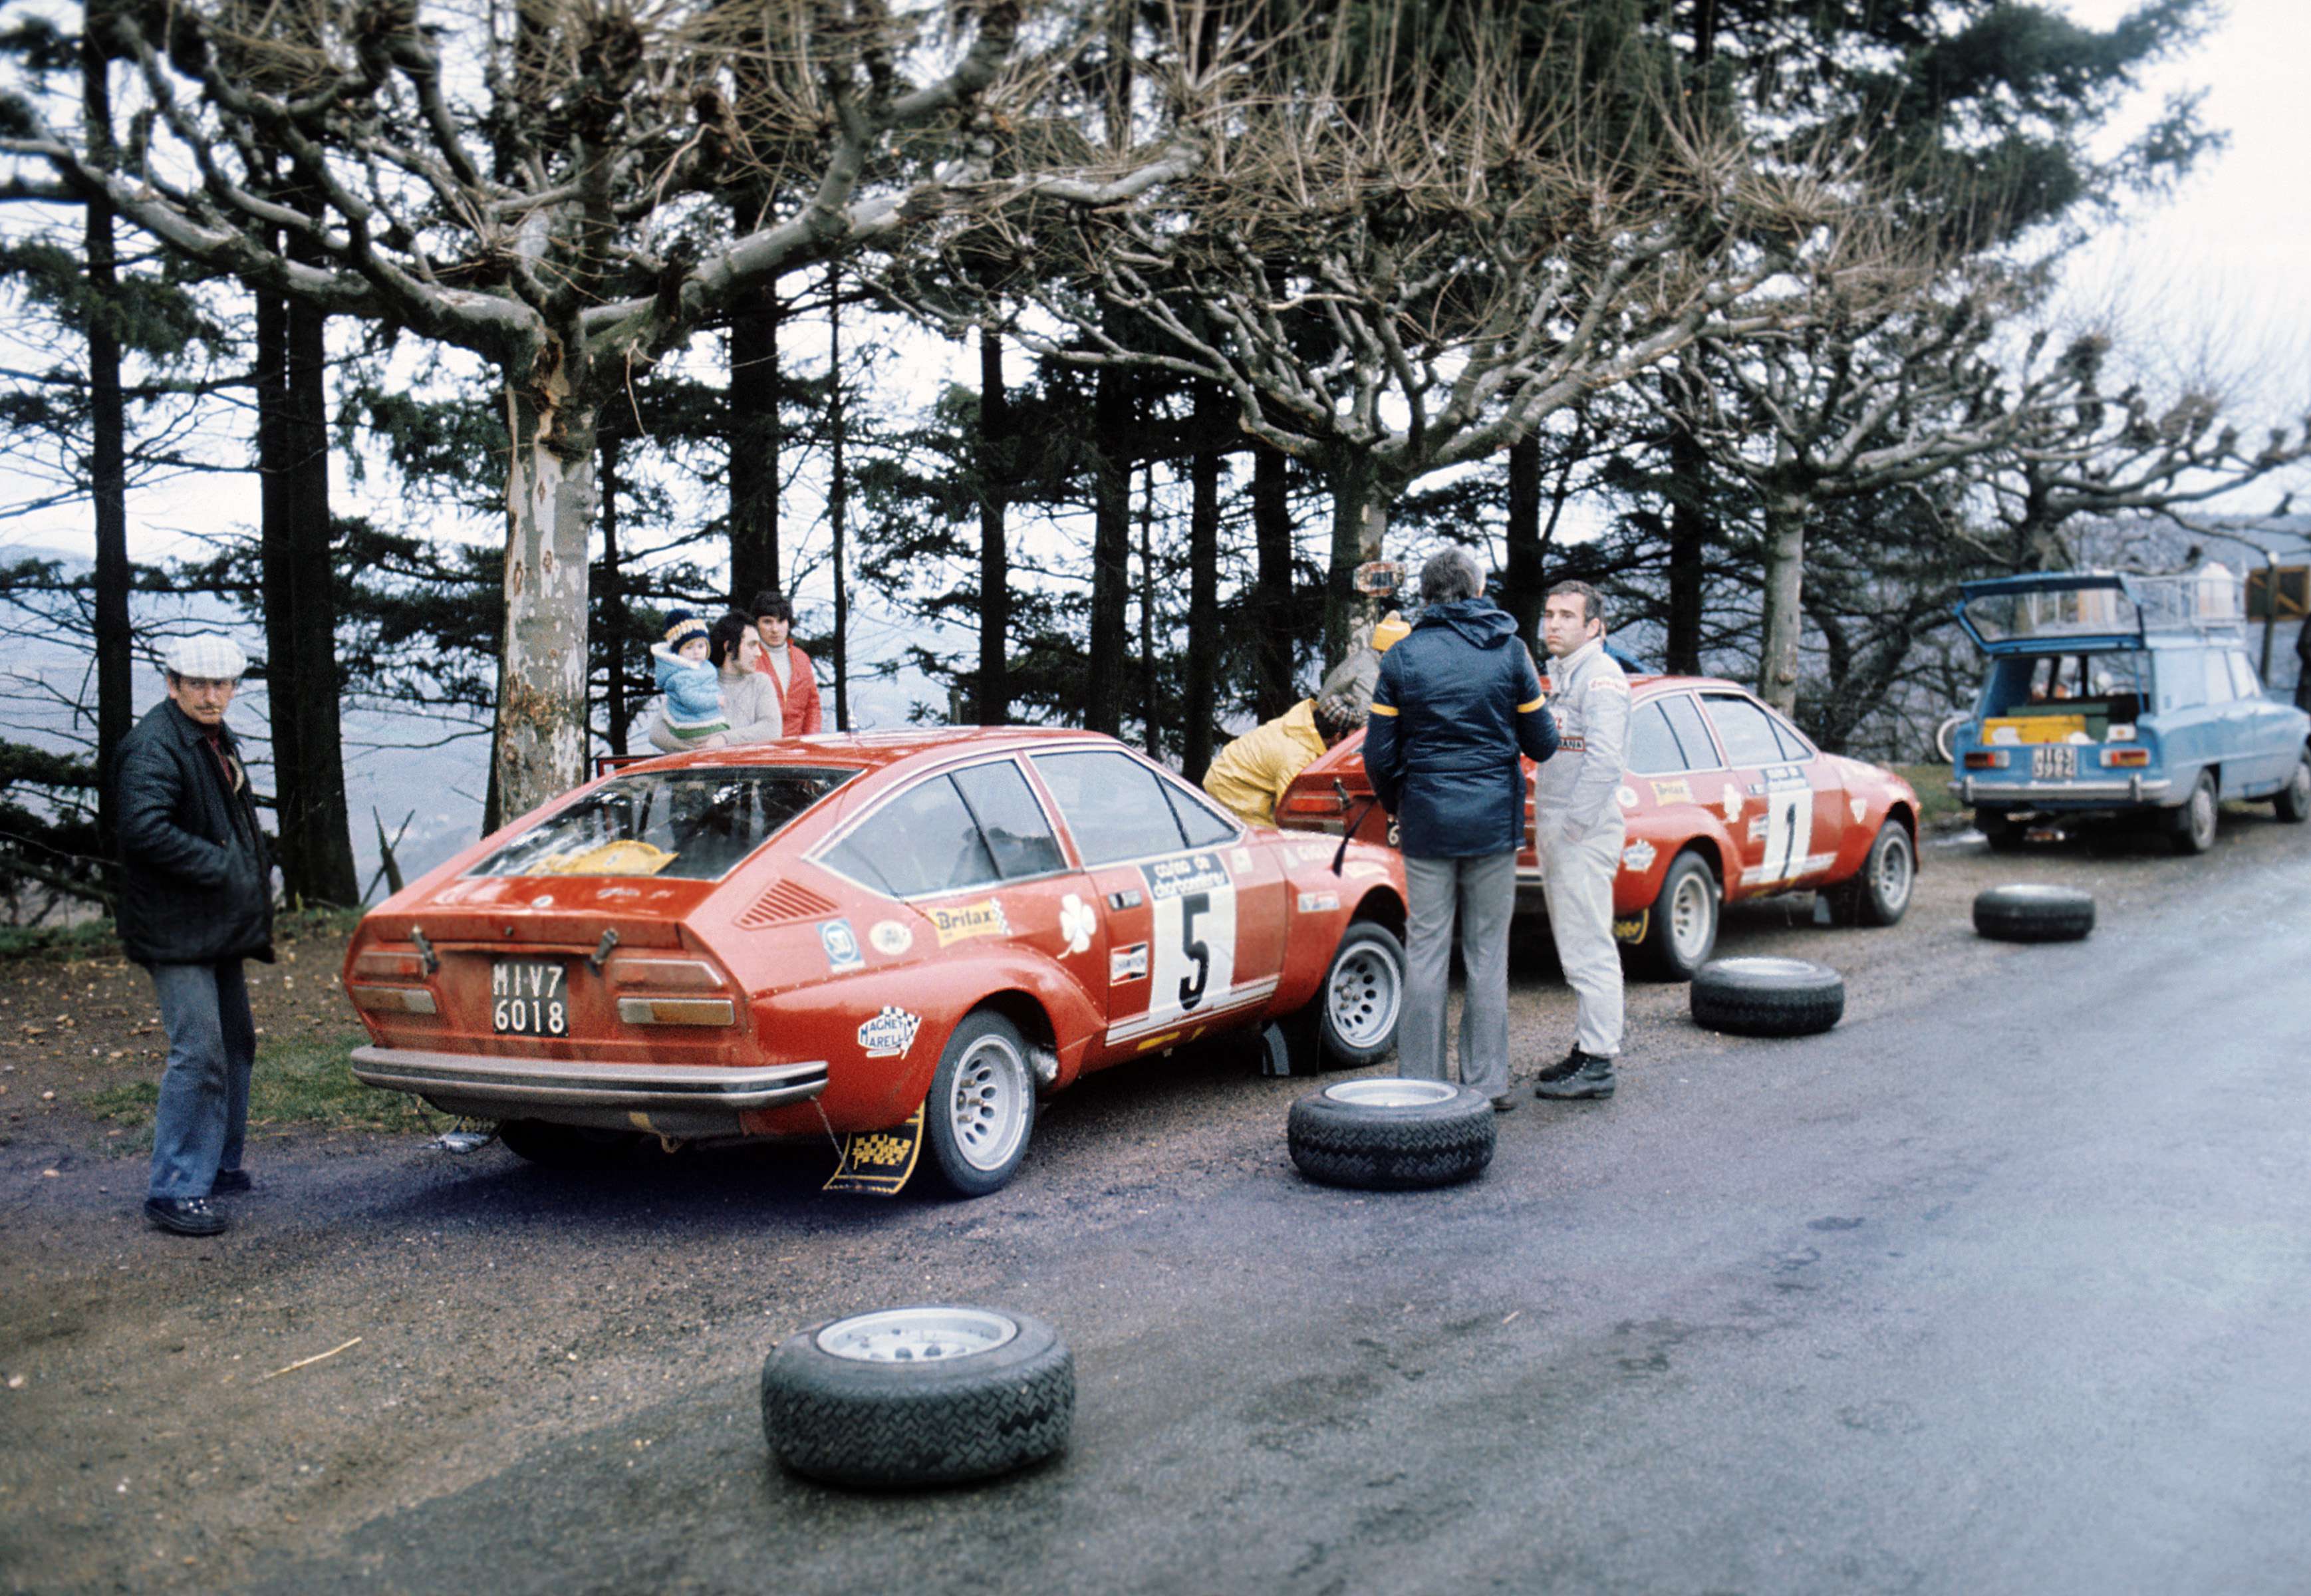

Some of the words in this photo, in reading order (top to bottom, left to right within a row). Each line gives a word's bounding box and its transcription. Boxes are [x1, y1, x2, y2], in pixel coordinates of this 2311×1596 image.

[1778, 802, 1796, 880] 1
[936, 910, 990, 930] Britax
[1179, 892, 1210, 1011] 5
[495, 999, 564, 1034] 6018
